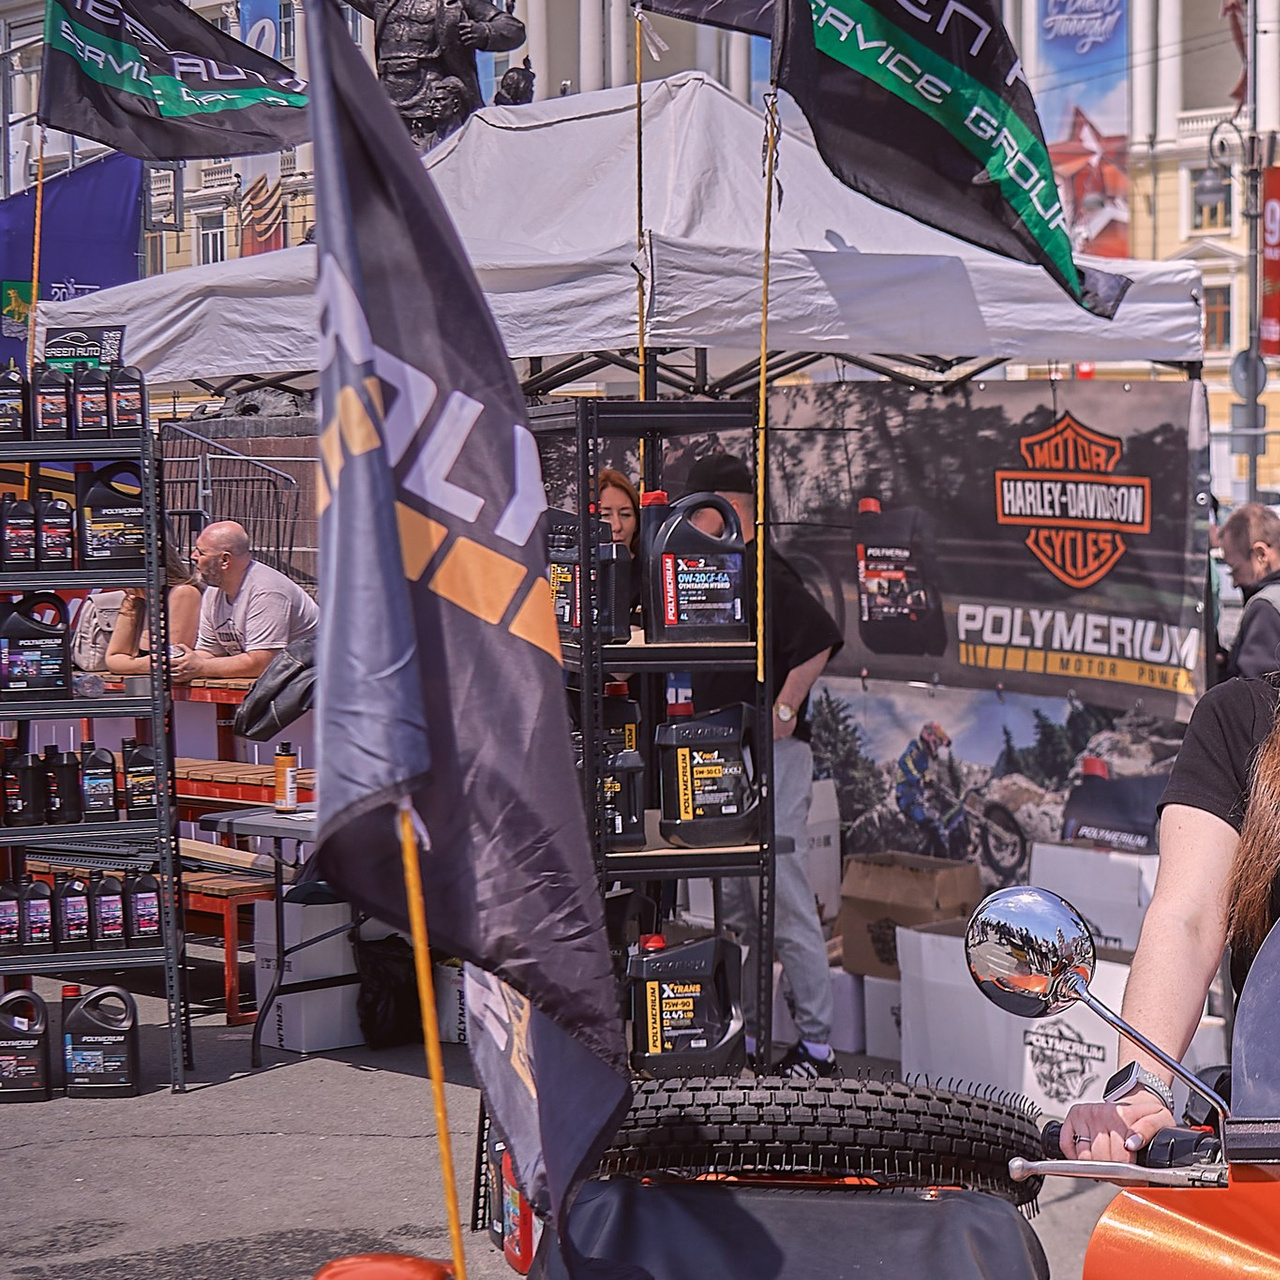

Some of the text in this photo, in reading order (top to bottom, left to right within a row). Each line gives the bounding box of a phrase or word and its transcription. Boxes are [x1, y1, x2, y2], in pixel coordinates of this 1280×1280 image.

[45, 346, 101, 357] GREEN AUTO
[1032, 426, 1108, 472] MOTOR
[1002, 480, 1144, 524] HARLEY-DAVIDSON
[1037, 529, 1112, 578] CYCLES
[665, 558, 676, 621] POLYMERIUM
[957, 603, 1200, 670] POLYMERIUM
[1059, 657, 1118, 678] MOTOR
[680, 753, 691, 815] POLYMERIUM
[1078, 825, 1149, 848] POLYMERIUM
[650, 986, 659, 1049] POLYMERIUM
[664, 1000, 691, 1008] 75W-90
